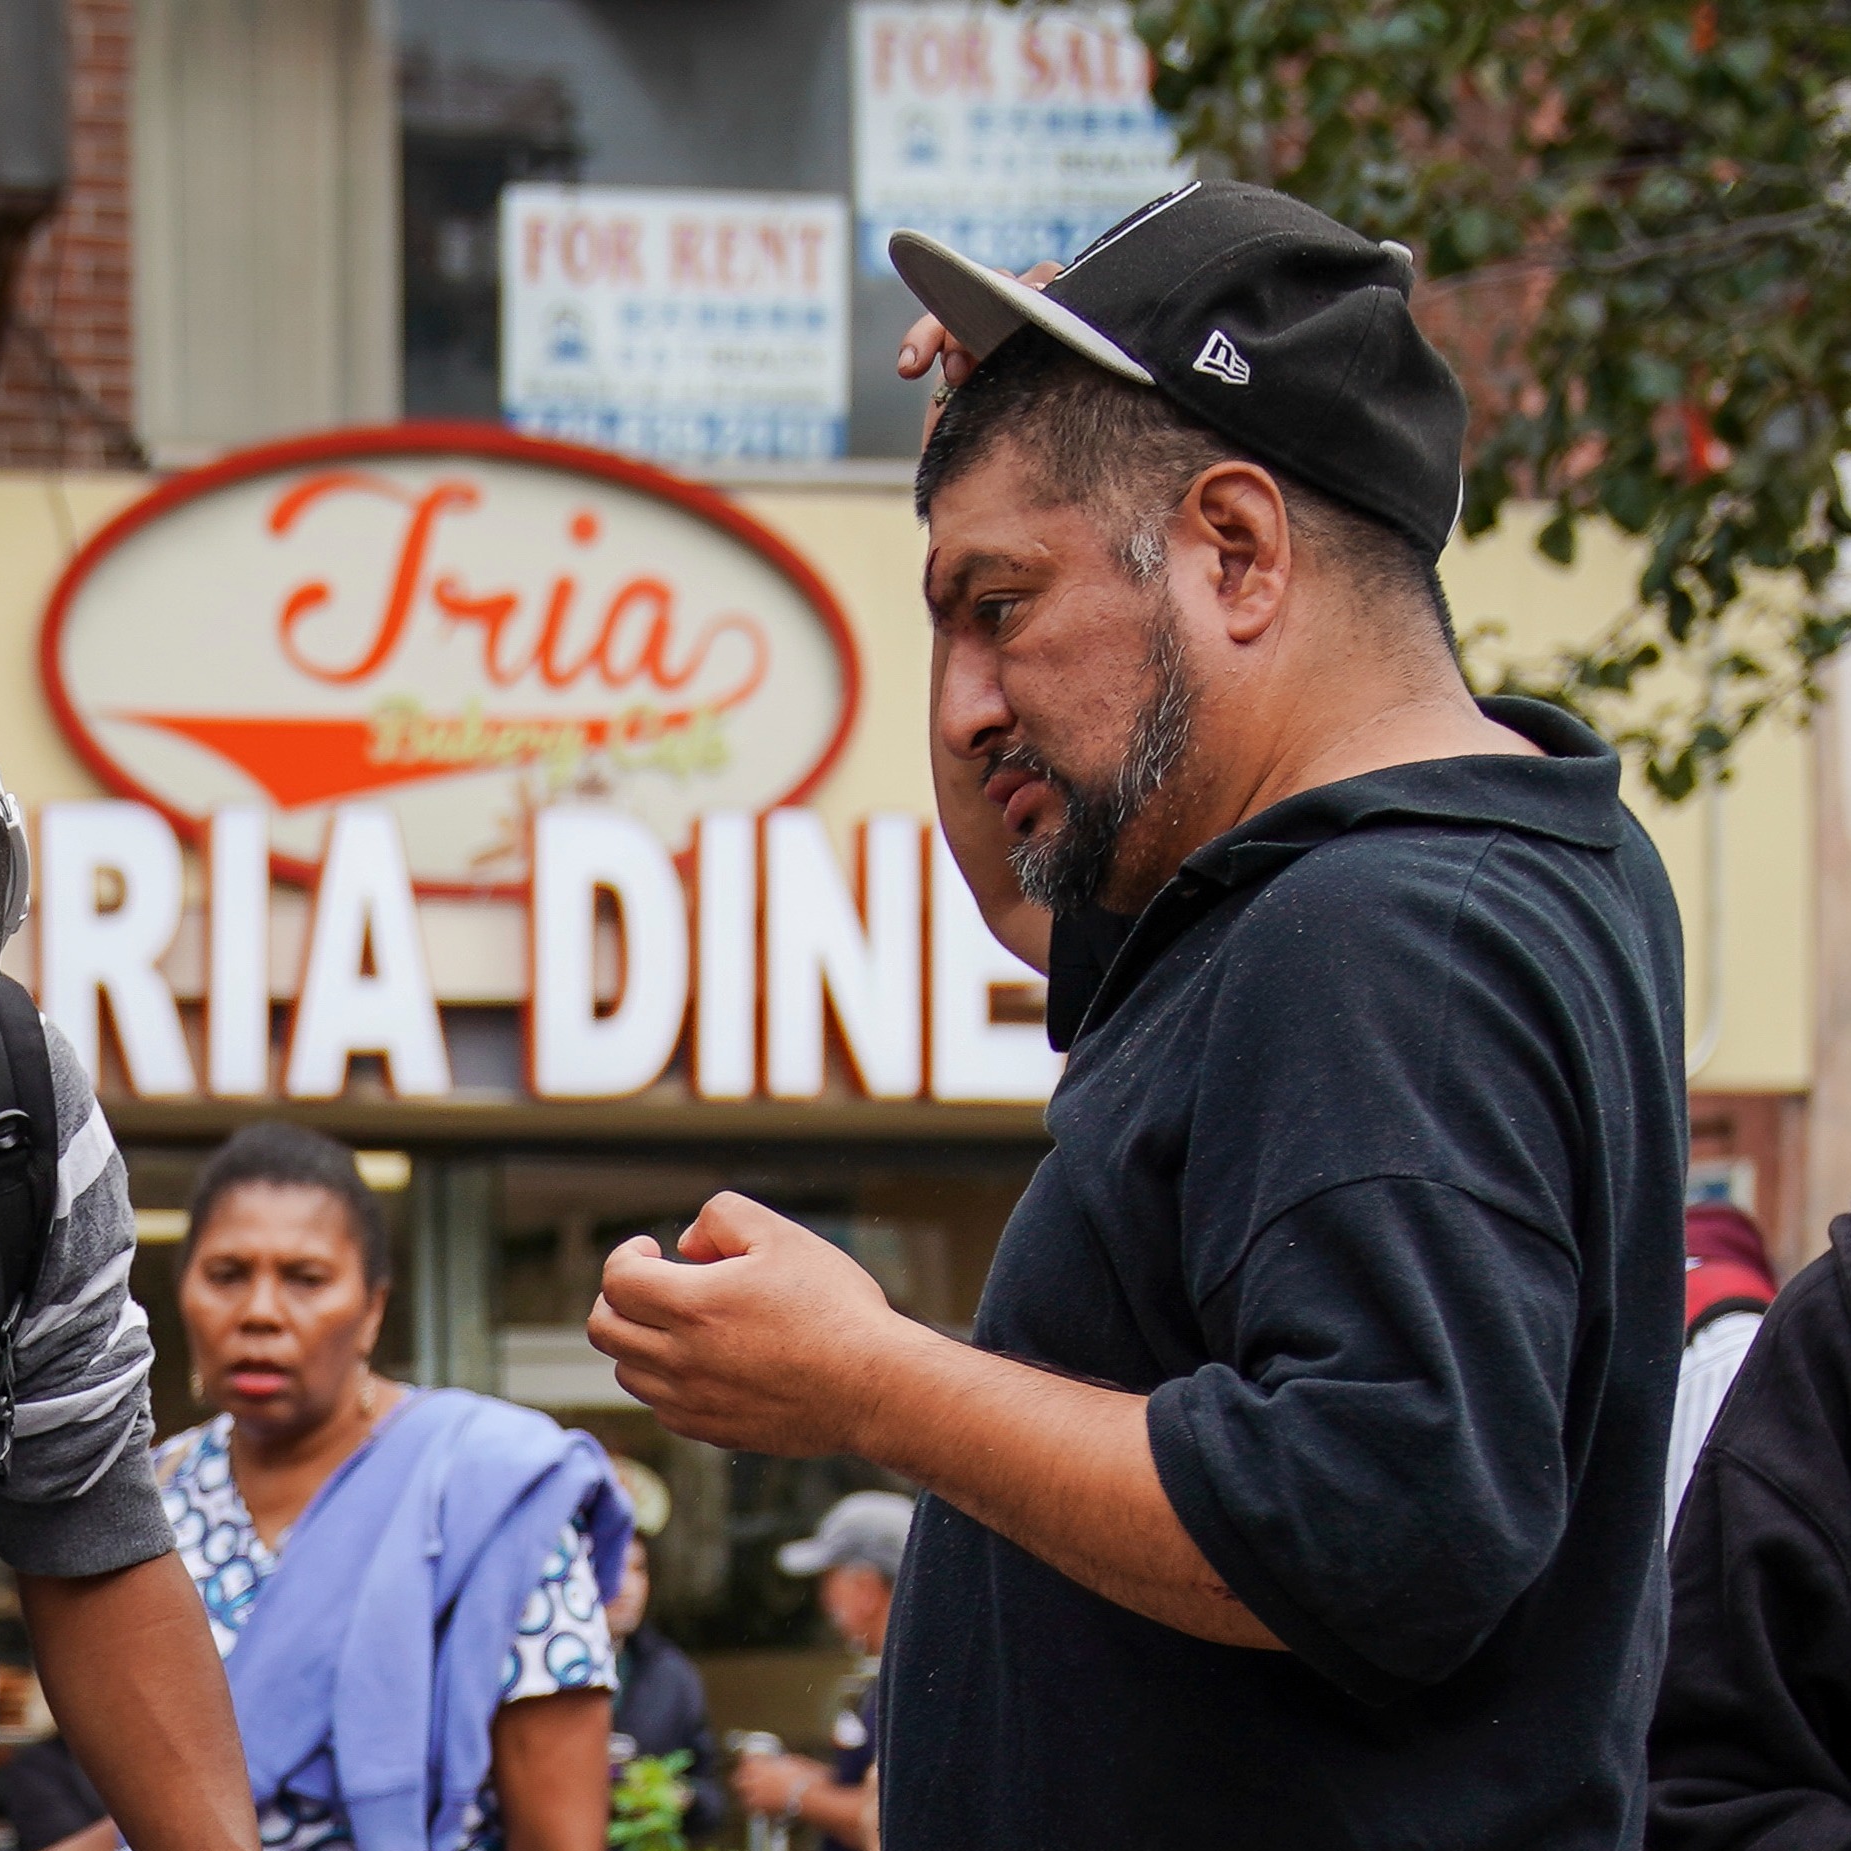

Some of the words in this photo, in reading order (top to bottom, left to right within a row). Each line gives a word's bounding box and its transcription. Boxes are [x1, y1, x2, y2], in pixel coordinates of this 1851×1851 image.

[871, 21, 994, 96] FOR
[521, 214, 644, 288] FOR
[669, 216, 828, 294] RENT
[265, 470, 770, 706] Tria
[39, 798, 452, 1100] RIA
[530, 808, 1065, 1102] DINE
